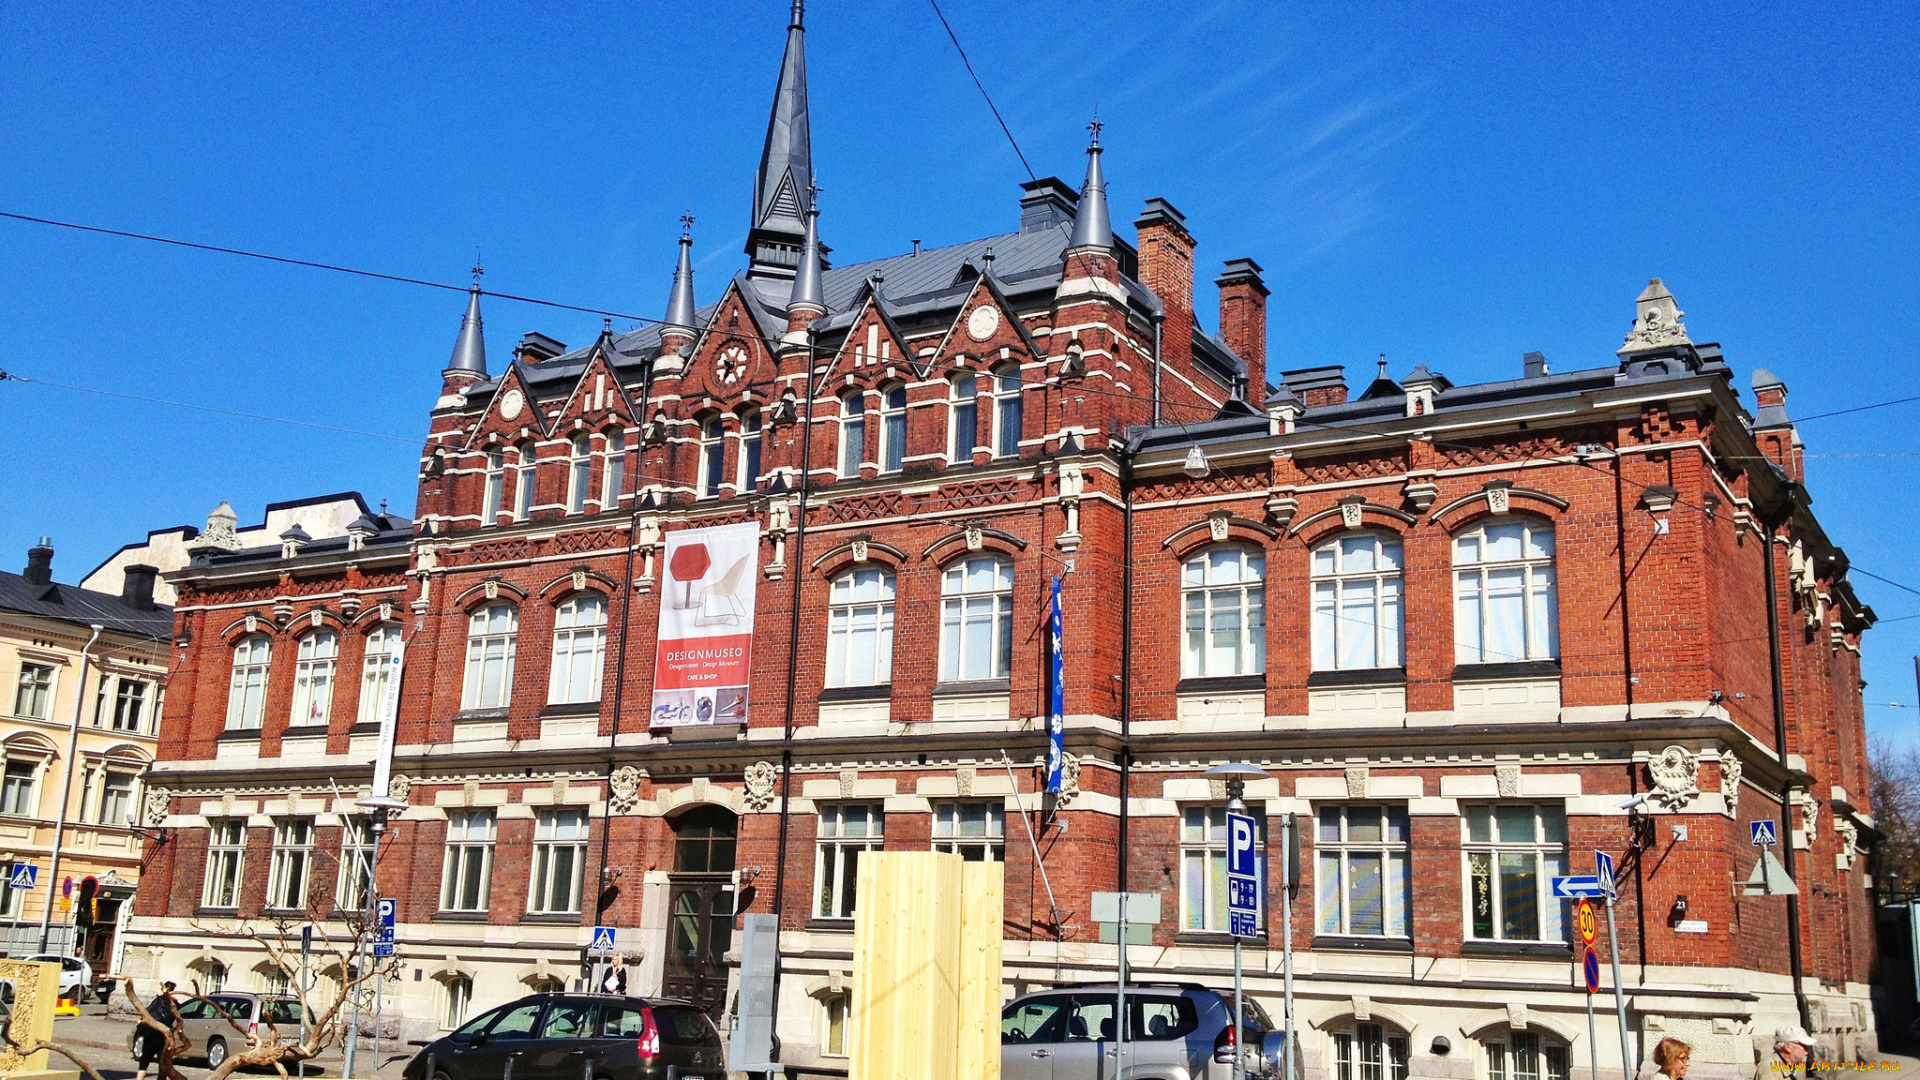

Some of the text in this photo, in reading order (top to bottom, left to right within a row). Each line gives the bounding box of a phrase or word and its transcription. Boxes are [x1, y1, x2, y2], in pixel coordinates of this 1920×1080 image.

[667, 647, 743, 662] DESIGNMUSEO
[702, 661, 718, 669] Design
[389, 667, 399, 691] WORLD
[386, 692, 395, 718] DESIGN
[382, 718, 391, 746] CAPITAL
[1233, 819, 1251, 870] P
[378, 900, 393, 926] P
[1676, 900, 1686, 909] 23
[1581, 910, 1593, 934] 30
